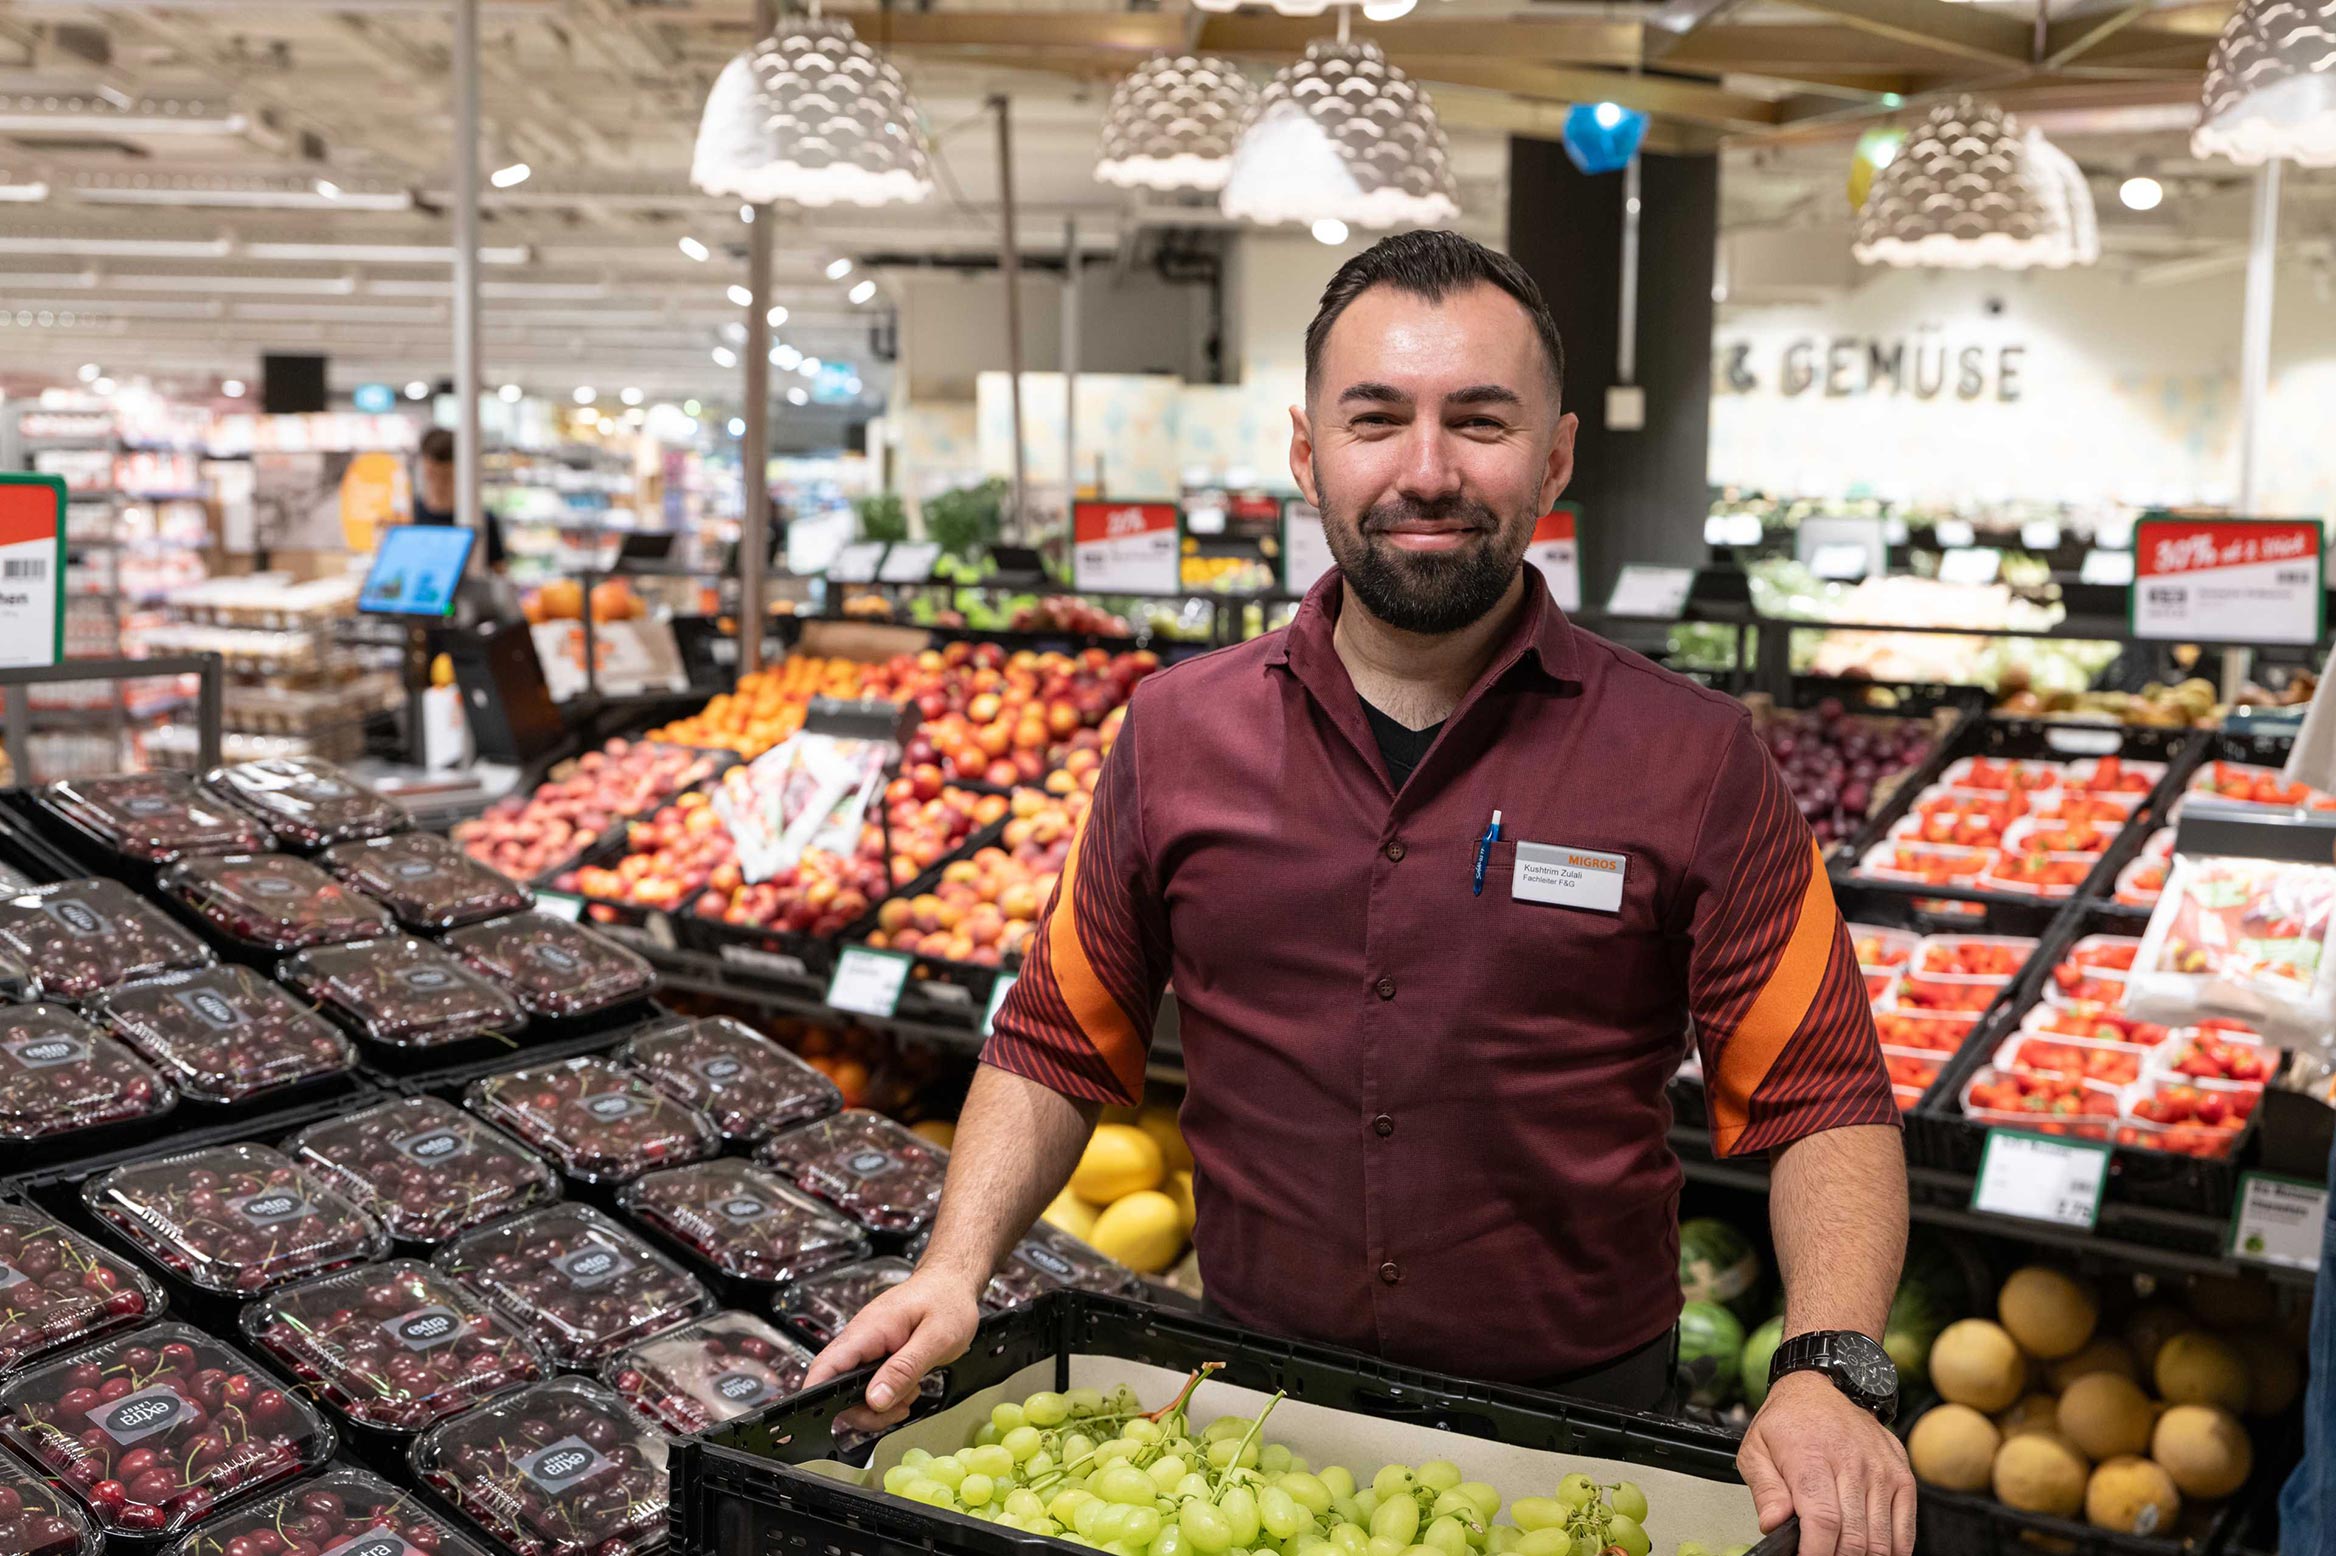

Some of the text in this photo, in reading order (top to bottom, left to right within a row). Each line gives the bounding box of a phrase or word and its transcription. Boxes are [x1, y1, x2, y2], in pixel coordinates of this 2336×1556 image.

[1781, 324, 2026, 402] GEMÜSE
[1568, 855, 1617, 870] MIGROS
[1523, 864, 1583, 880] Kushtrim Zulali
[1522, 873, 1576, 889] Fachleiter F&G
[407, 1316, 449, 1335] extra
[120, 1402, 169, 1426] extra
[121, 1401, 151, 1415] LARGE
[544, 1453, 585, 1475] extra
